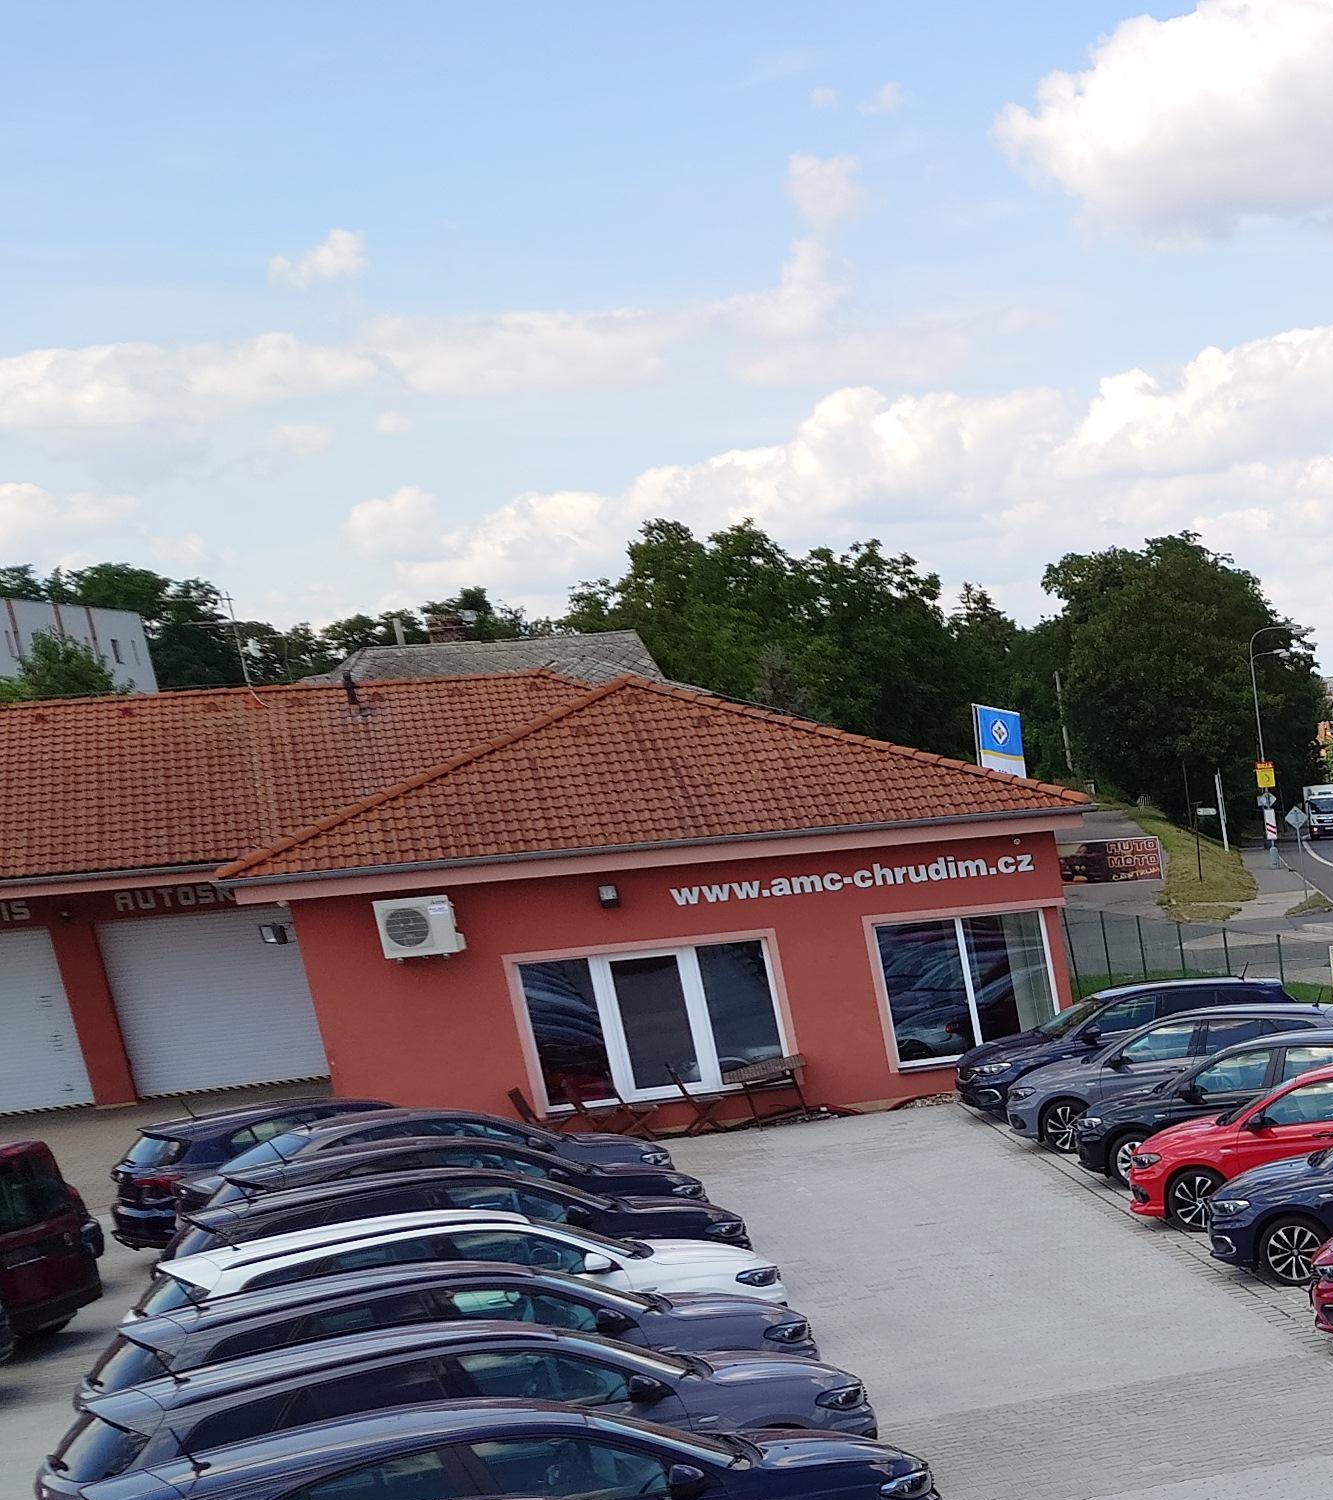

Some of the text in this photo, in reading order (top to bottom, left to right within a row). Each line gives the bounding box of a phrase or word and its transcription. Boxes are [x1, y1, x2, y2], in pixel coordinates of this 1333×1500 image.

[1106, 840, 1157, 853] AUTO
[1107, 854, 1159, 868] MOTO
[670, 853, 1034, 906] www.amc-chrudim.cz
